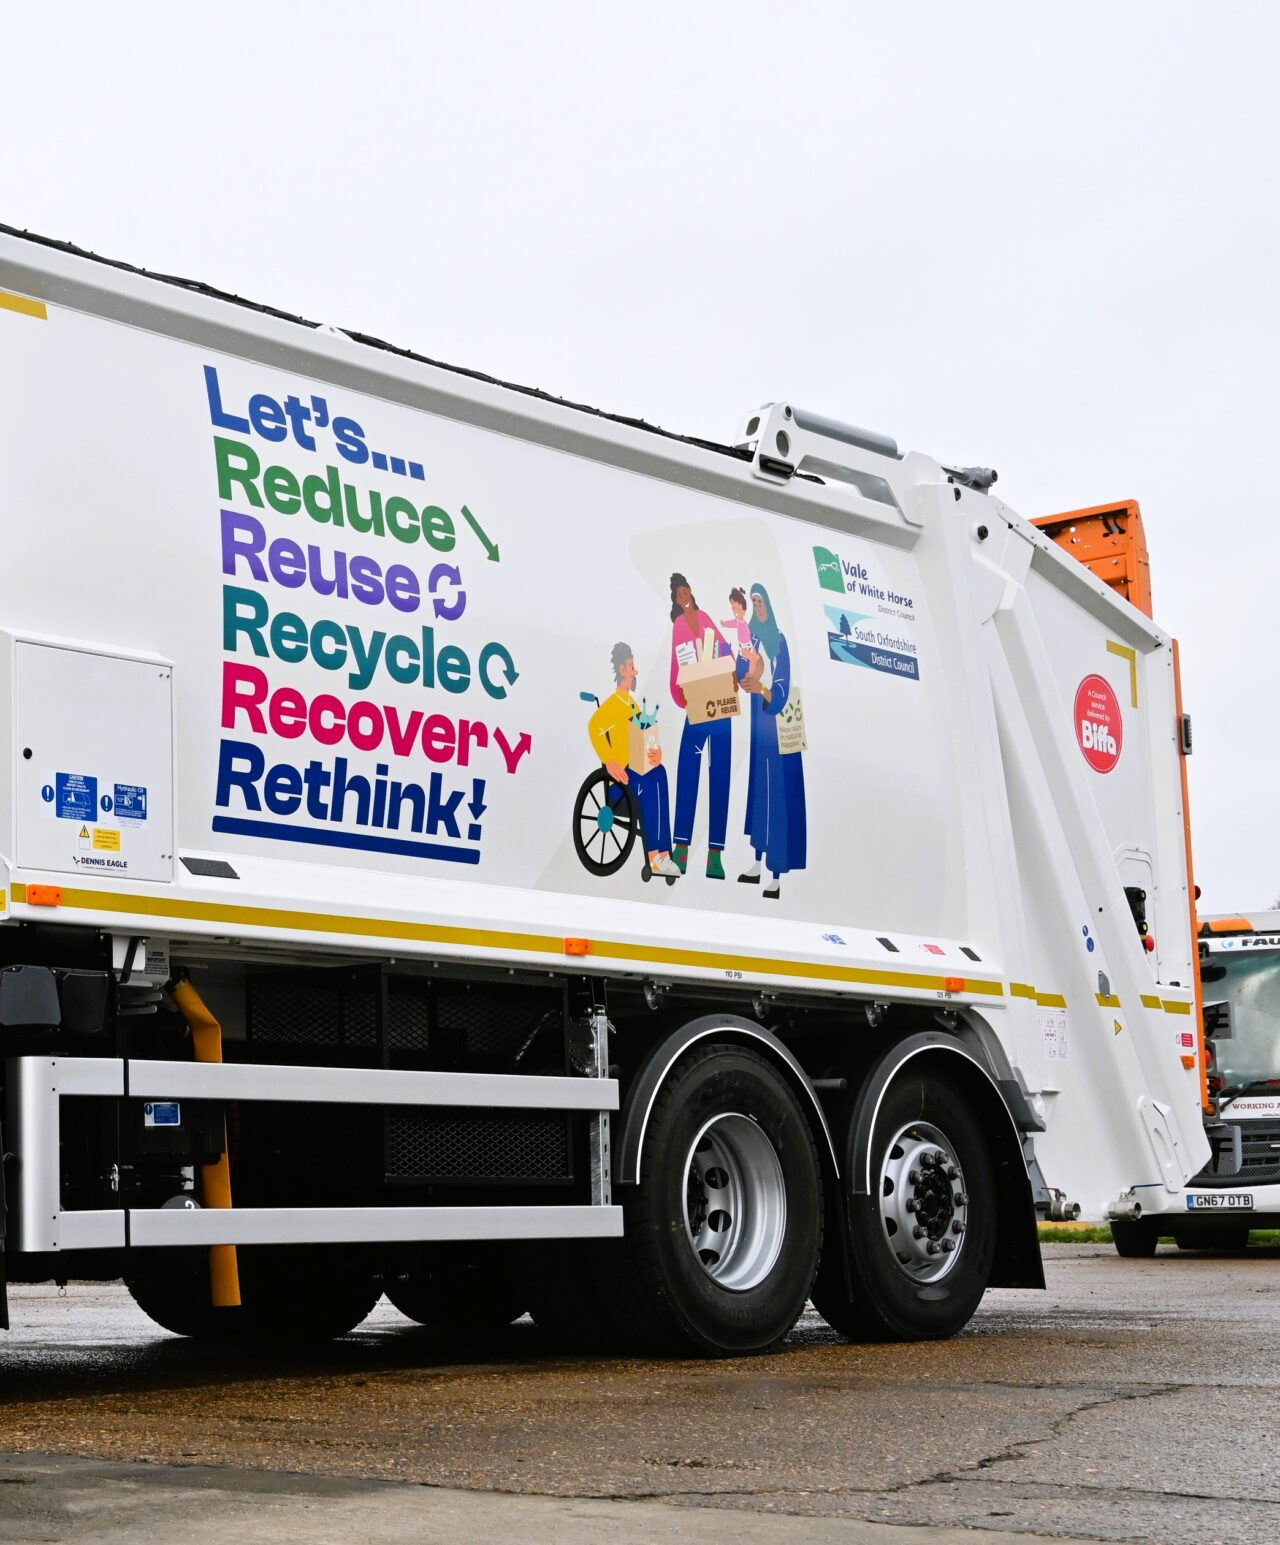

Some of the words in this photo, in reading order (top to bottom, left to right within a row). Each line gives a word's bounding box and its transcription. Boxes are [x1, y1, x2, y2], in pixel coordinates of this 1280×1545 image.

[213, 435, 456, 552] Reduce
[220, 509, 421, 613] Reuse
[842, 560, 868, 580] Vale
[847, 580, 856, 592] of
[859, 583, 885, 600] White
[888, 591, 913, 608] Horse
[878, 605, 897, 616] District
[897, 609, 915, 621] Council
[223, 584, 471, 694] Recycle
[855, 627, 876, 643] South
[877, 632, 917, 654] Oxfordshire
[871, 652, 892, 665] District
[893, 658, 915, 674] Council
[717, 697, 737, 707] PLEASE
[721, 705, 738, 714] REUSE
[221, 661, 532, 774] Recovery
[1081, 720, 1117, 756] Biffa
[117, 785, 137, 793] Hydraulic
[81, 857, 105, 866] DENNIS
[107, 860, 127, 868] EAGLE
[1196, 1196, 1225, 1206] GN67
[1228, 1195, 1250, 1206] OTB
